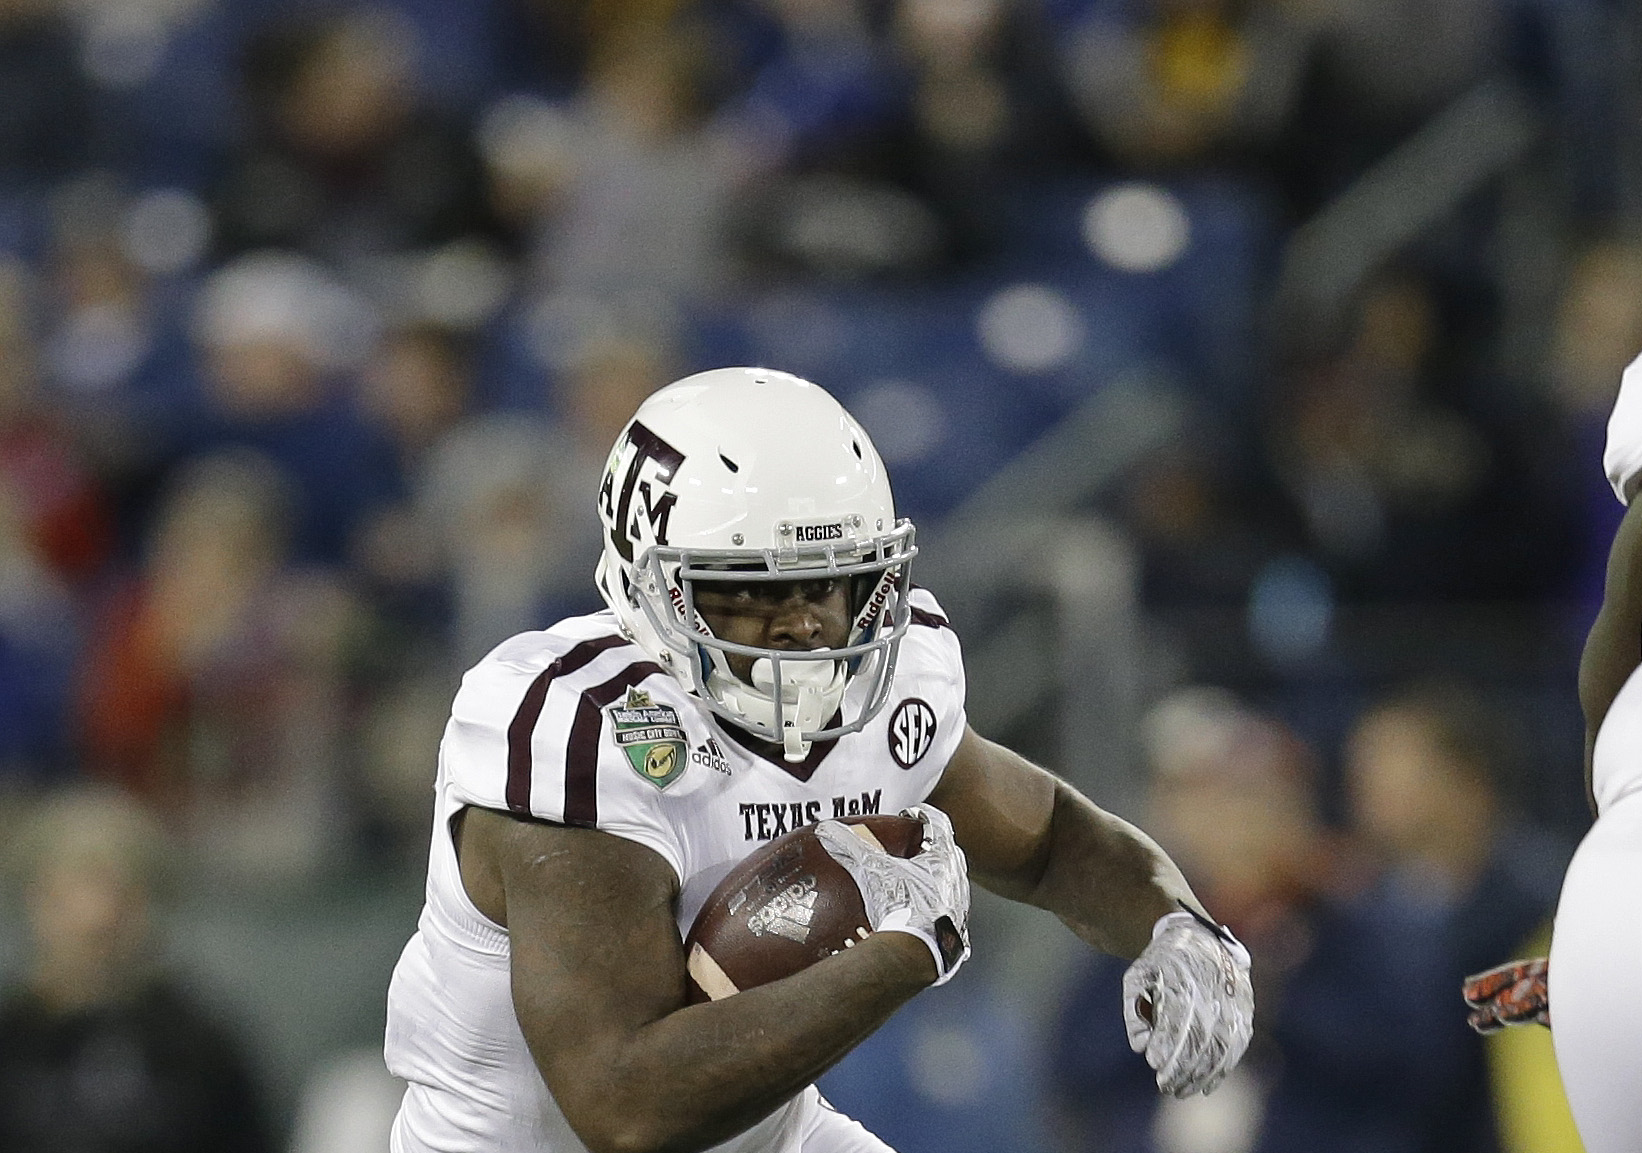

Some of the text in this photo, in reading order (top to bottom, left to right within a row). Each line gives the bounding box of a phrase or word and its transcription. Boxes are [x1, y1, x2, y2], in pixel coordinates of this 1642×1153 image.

[796, 524, 843, 541] AGGIES
[857, 571, 895, 629] Riddell
[892, 703, 935, 765] SEC
[692, 752, 733, 776] adidas
[739, 788, 882, 841] TEXAS A&M
